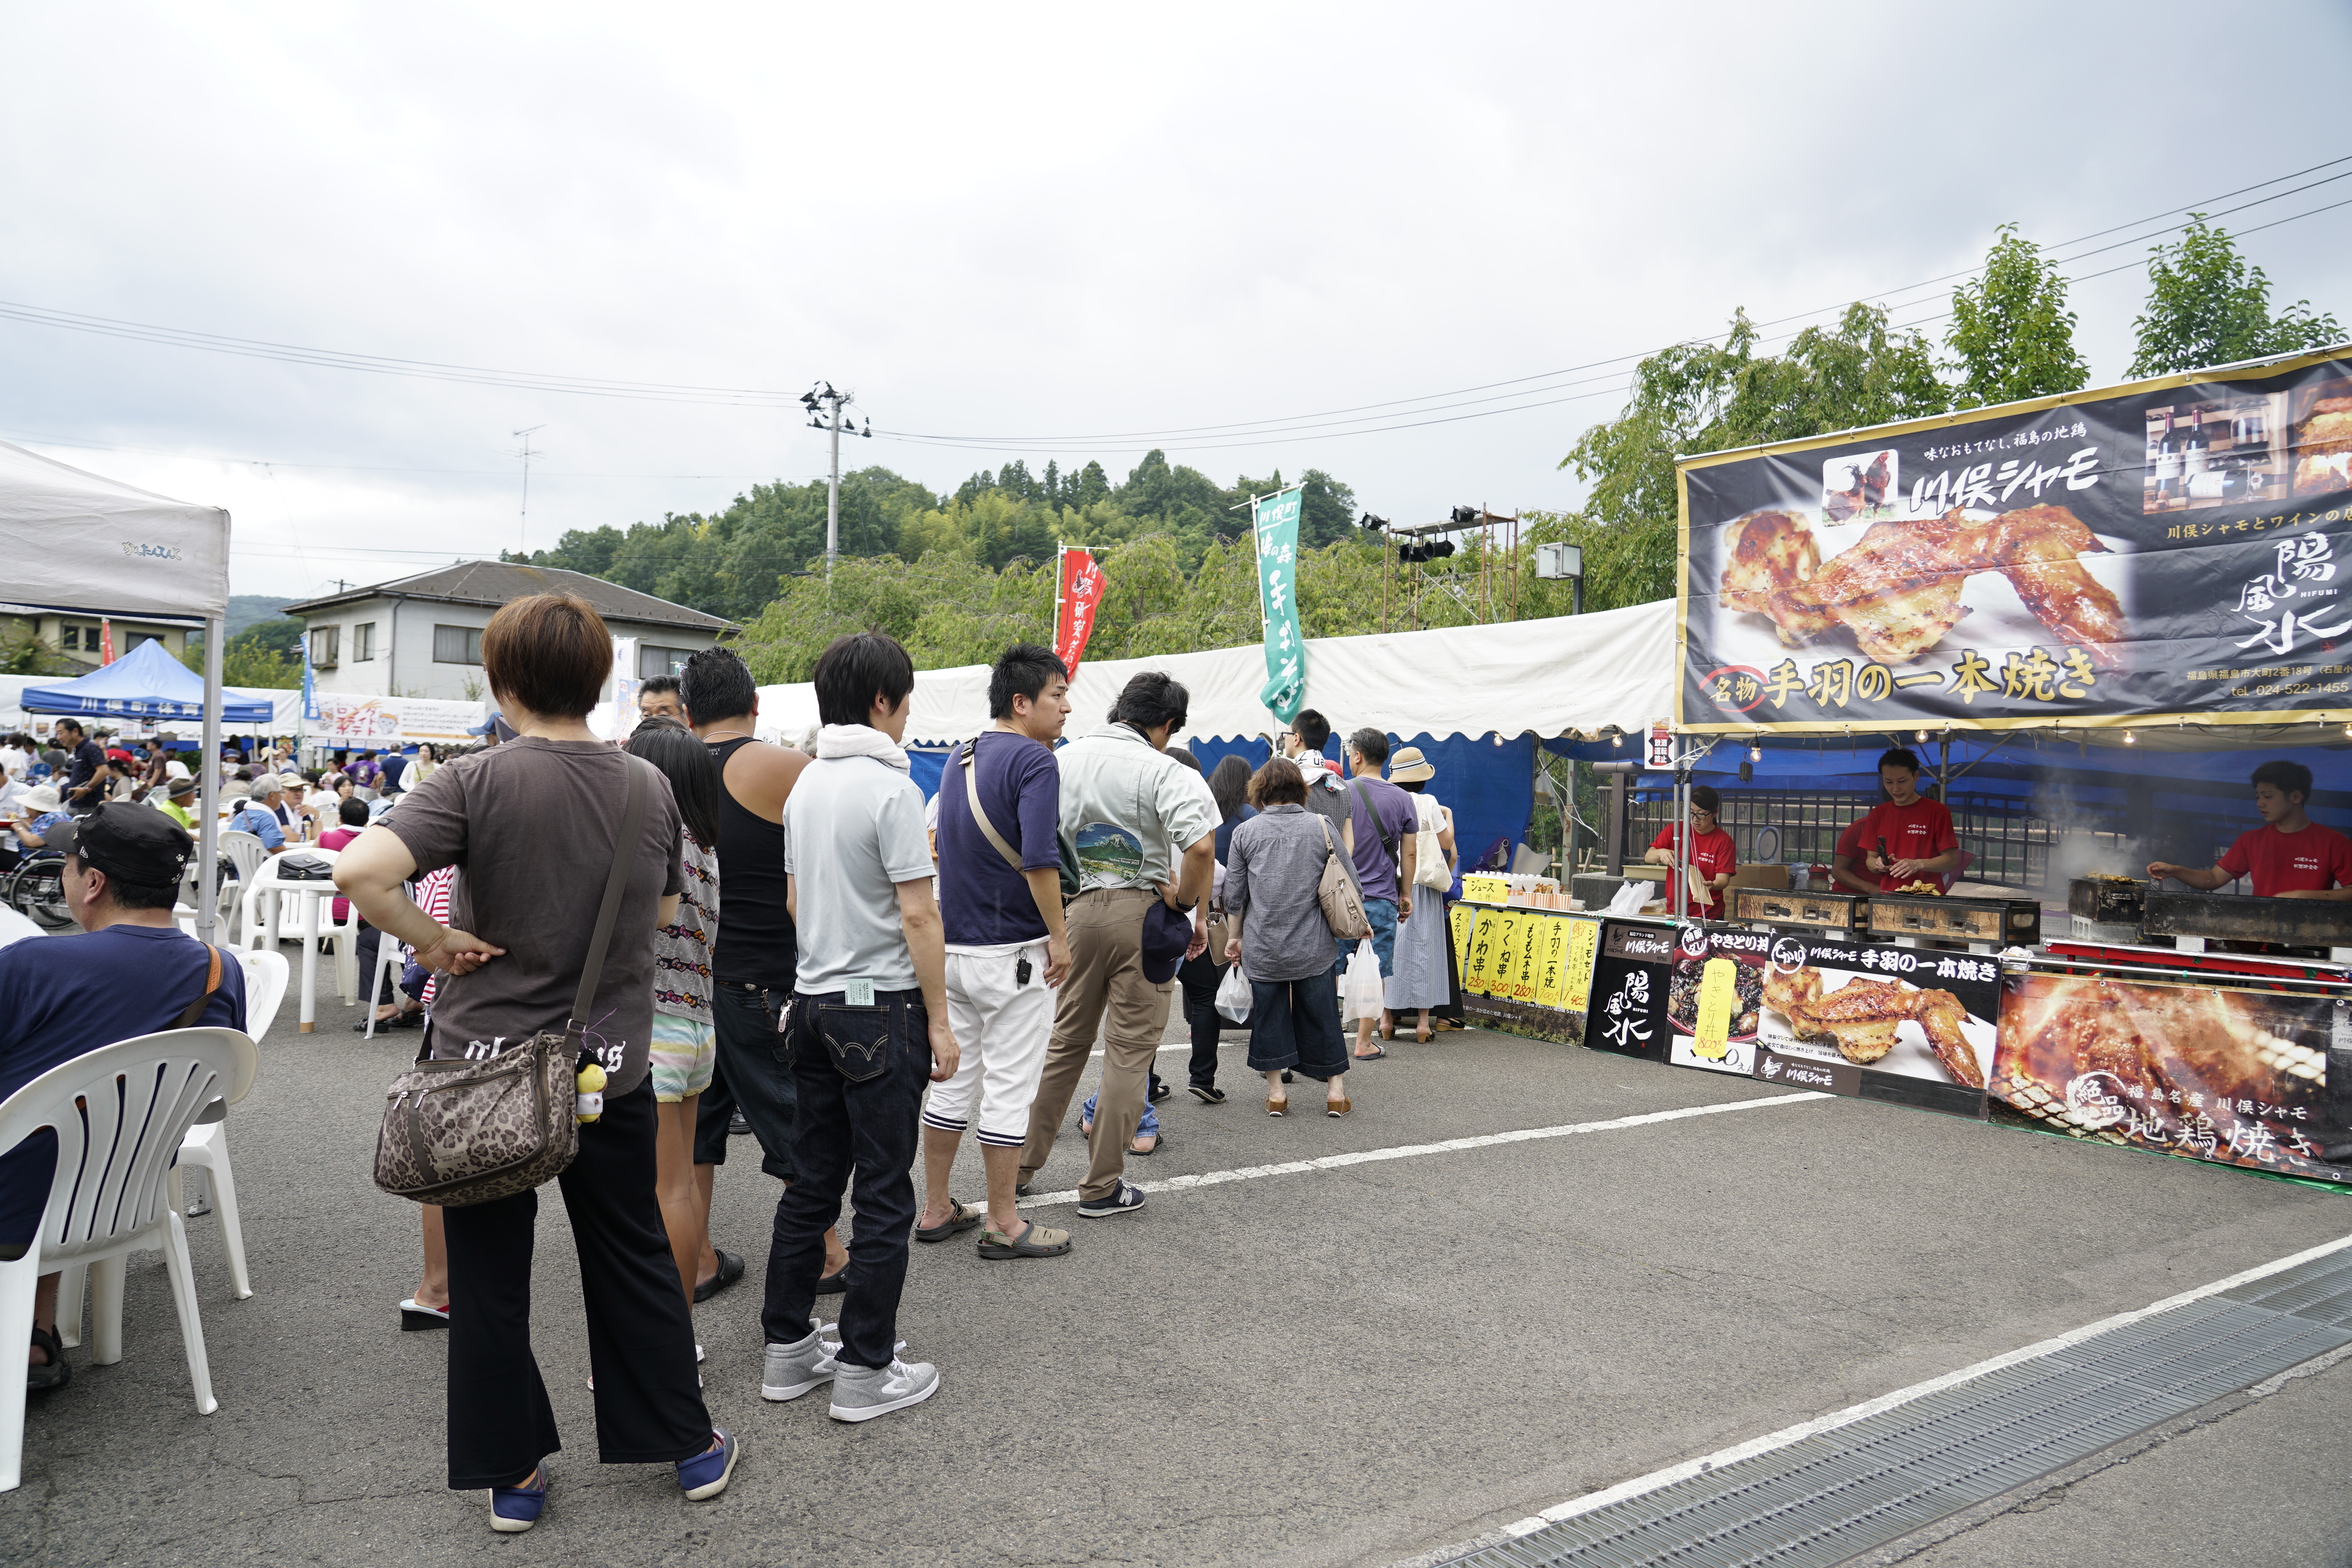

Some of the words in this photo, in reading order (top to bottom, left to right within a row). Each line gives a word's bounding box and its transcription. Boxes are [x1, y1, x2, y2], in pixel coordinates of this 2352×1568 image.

[1924, 422, 2087, 461] 味なおもてなし、福島の地鶏
[1910, 447, 2099, 515] 川俣シャモ
[1259, 501, 1298, 527] 川俣町
[2301, 589, 2337, 597] HIFUMI
[1710, 676, 1756, 703] 名物
[1762, 648, 2096, 708] 手羽の一本焼き
[2231, 685, 2249, 696] tel.
[2256, 682, 2348, 696] 024-522-1455
[80, 698, 226, 716] 川俣町体育
[1654, 747, 1667, 755] 運転
[1472, 880, 1494, 892] ジュース
[1473, 919, 1492, 977] かわ串
[1497, 920, 1514, 979] つくね串
[1543, 921, 1562, 988] 手羽の一本焼
[1584, 930, 1594, 982] シャモセット
[1625, 940, 1669, 953] 川俣シャモ
[1710, 933, 1769, 952] やきとり丼
[1810, 947, 1857, 962] 川俣シャモ
[1860, 949, 1997, 982] 手羽の一本焼き
[1786, 1069, 1832, 1086] 川俣シャモ
[2076, 1080, 2124, 1117] 絶品
[2128, 1084, 2204, 1108] 福島名産
[2217, 1097, 2307, 1120] 川俣シャモ
[2124, 1106, 2311, 1167] 地鶏焼き
